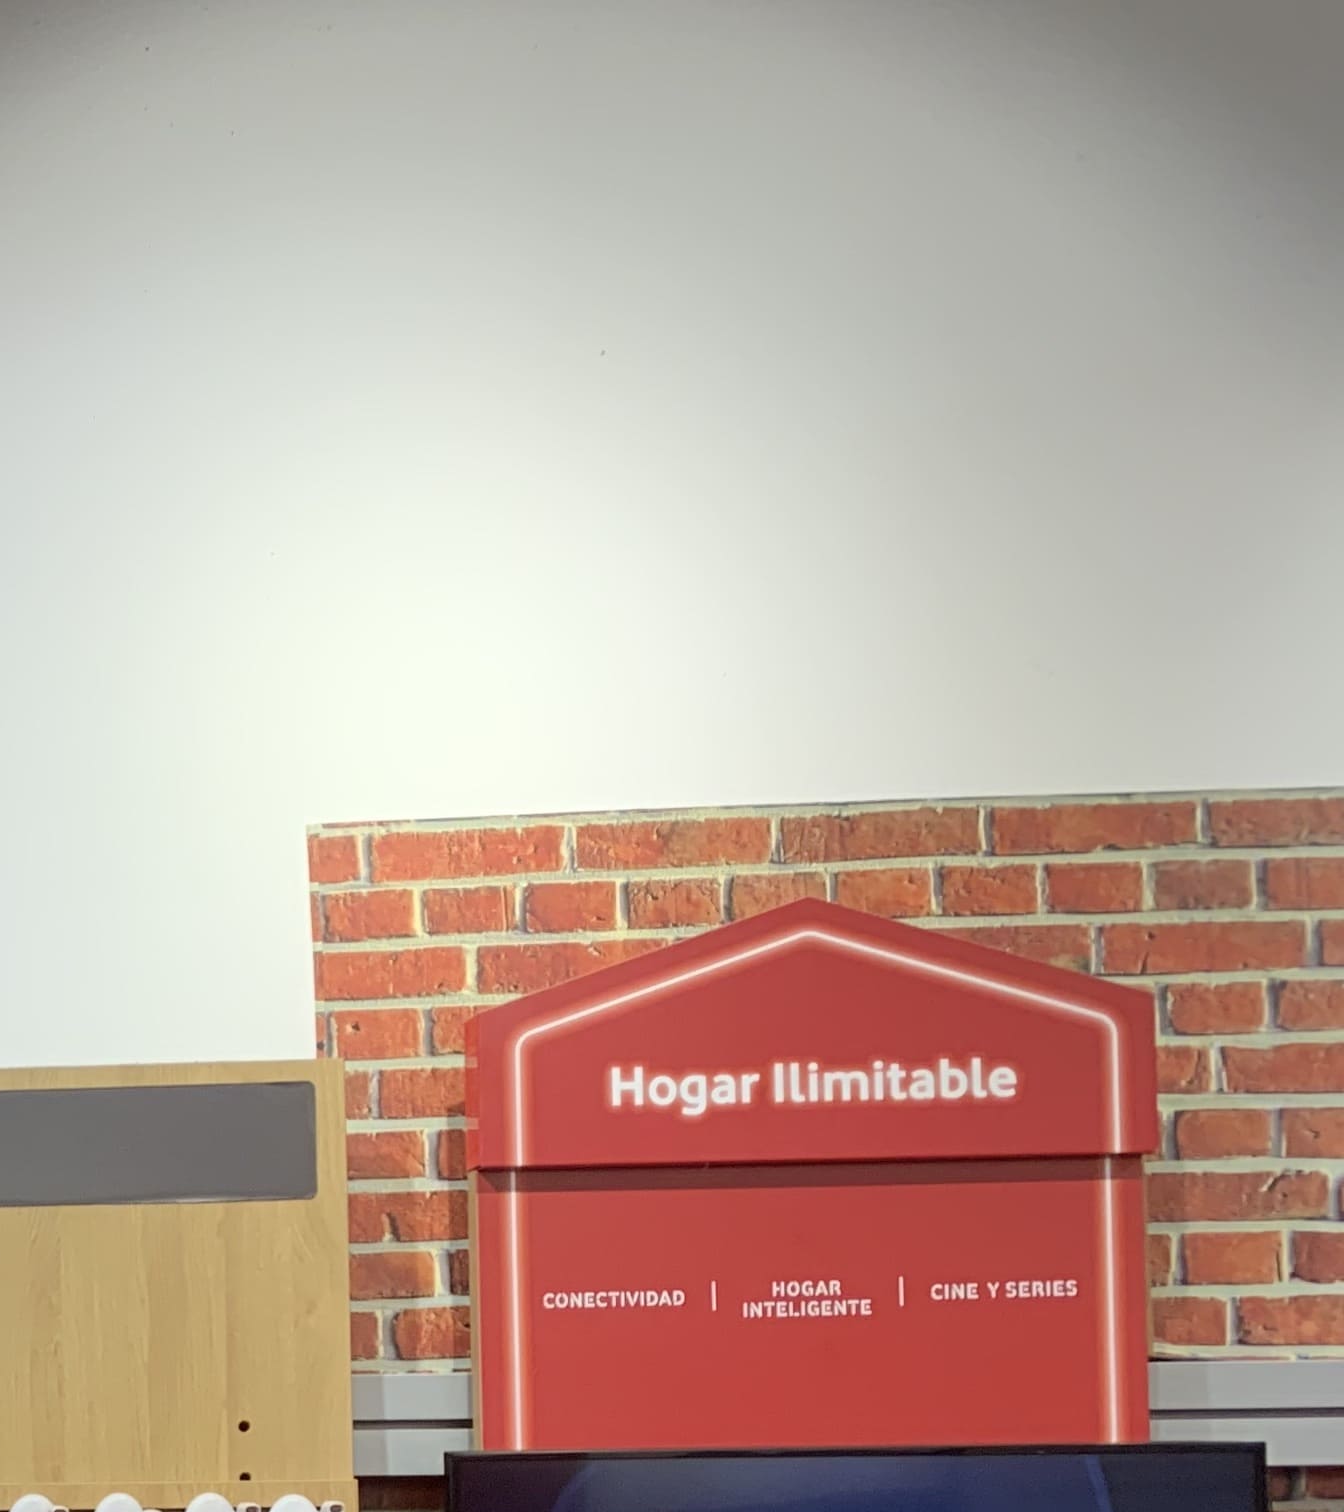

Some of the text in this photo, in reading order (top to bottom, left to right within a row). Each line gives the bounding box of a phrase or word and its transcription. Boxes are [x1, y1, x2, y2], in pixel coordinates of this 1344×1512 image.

[610, 1057, 1017, 1116] Hogar Ilimitable
[772, 1280, 841, 1297] HOGAR
[931, 1280, 1077, 1300] CINE Y SERIES
[543, 1290, 684, 1308] CONECTIVIDAD
[743, 1299, 872, 1318] INTELIGENTE
